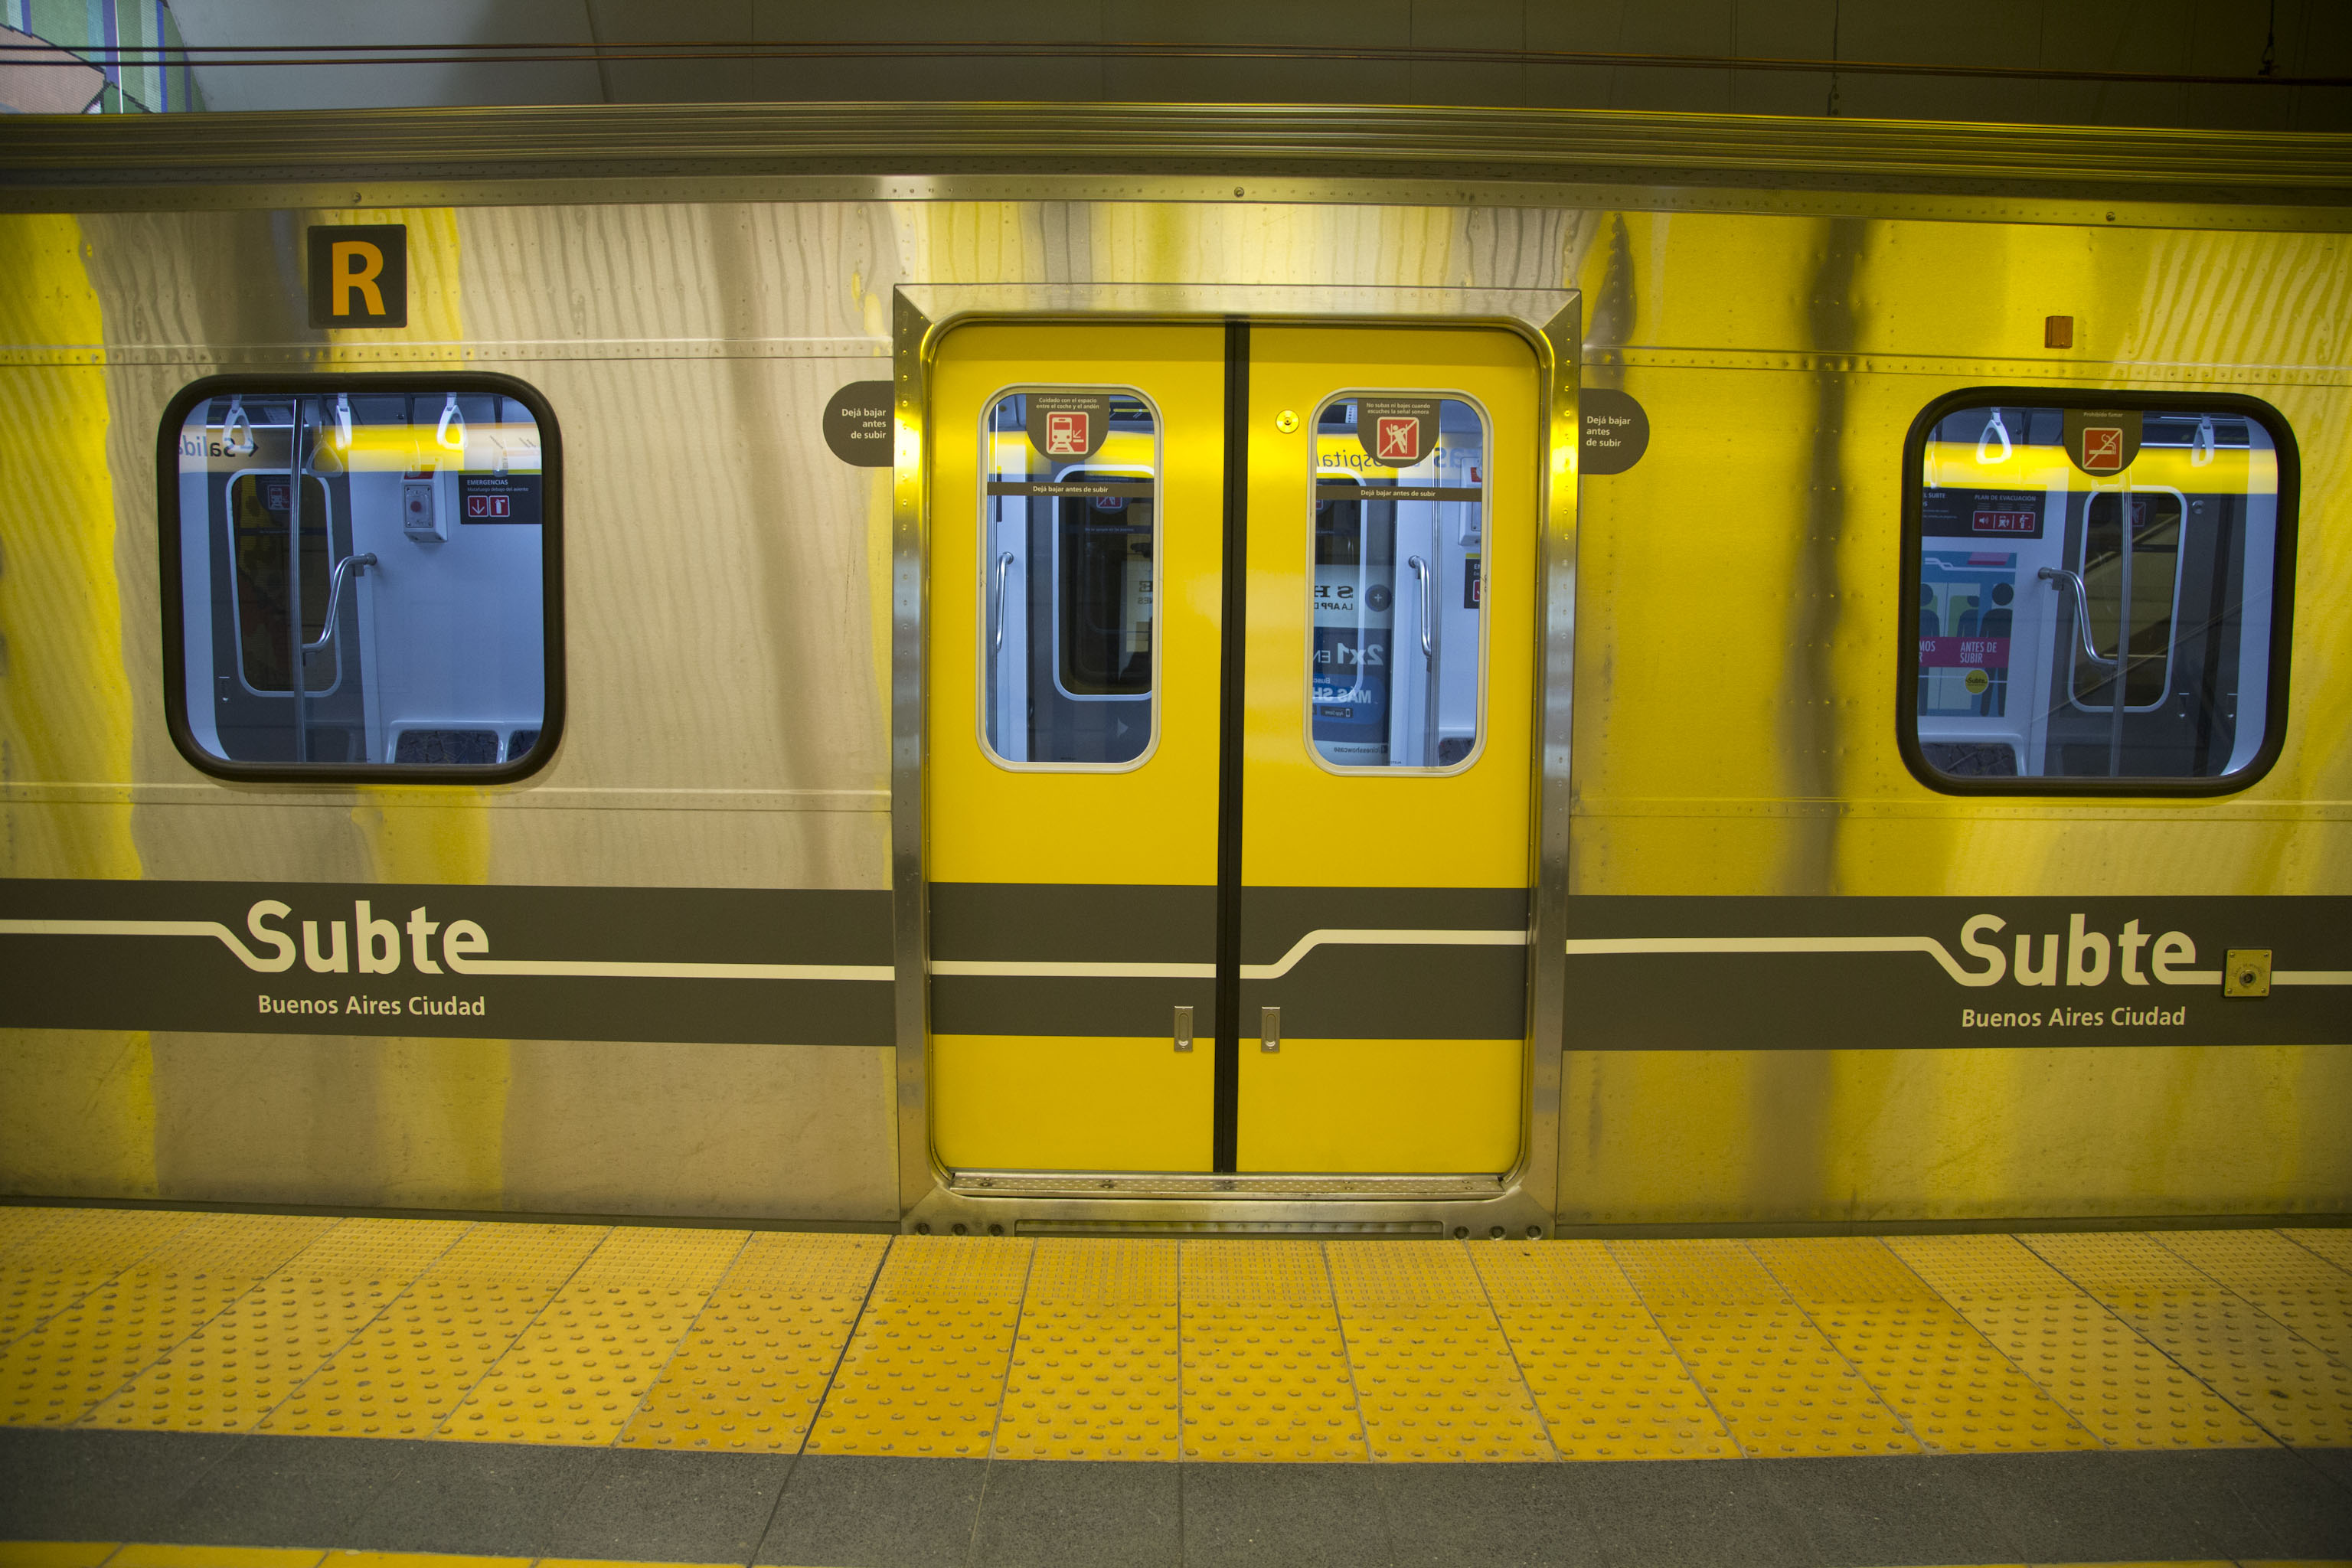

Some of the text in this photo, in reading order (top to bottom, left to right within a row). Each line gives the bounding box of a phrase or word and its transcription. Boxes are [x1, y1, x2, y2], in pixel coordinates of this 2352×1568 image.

[332, 240, 386, 315] R
[841, 407, 887, 419] Dejá bajar
[863, 420, 887, 428] antes
[1586, 416, 1632, 426] Dejá bajar
[851, 430, 887, 439] de subir
[1586, 427, 1610, 436] antes
[1586, 438, 1622, 447] de subir
[1960, 642, 1997, 652] ANTES DE
[1960, 652, 1983, 663] SUBIR
[247, 900, 489, 975] Subte
[1960, 913, 2197, 987] Subte
[258, 995, 486, 1016] Buenos Aires Ciudad
[1962, 1006, 2186, 1027] Buenos Aires Ciudad
